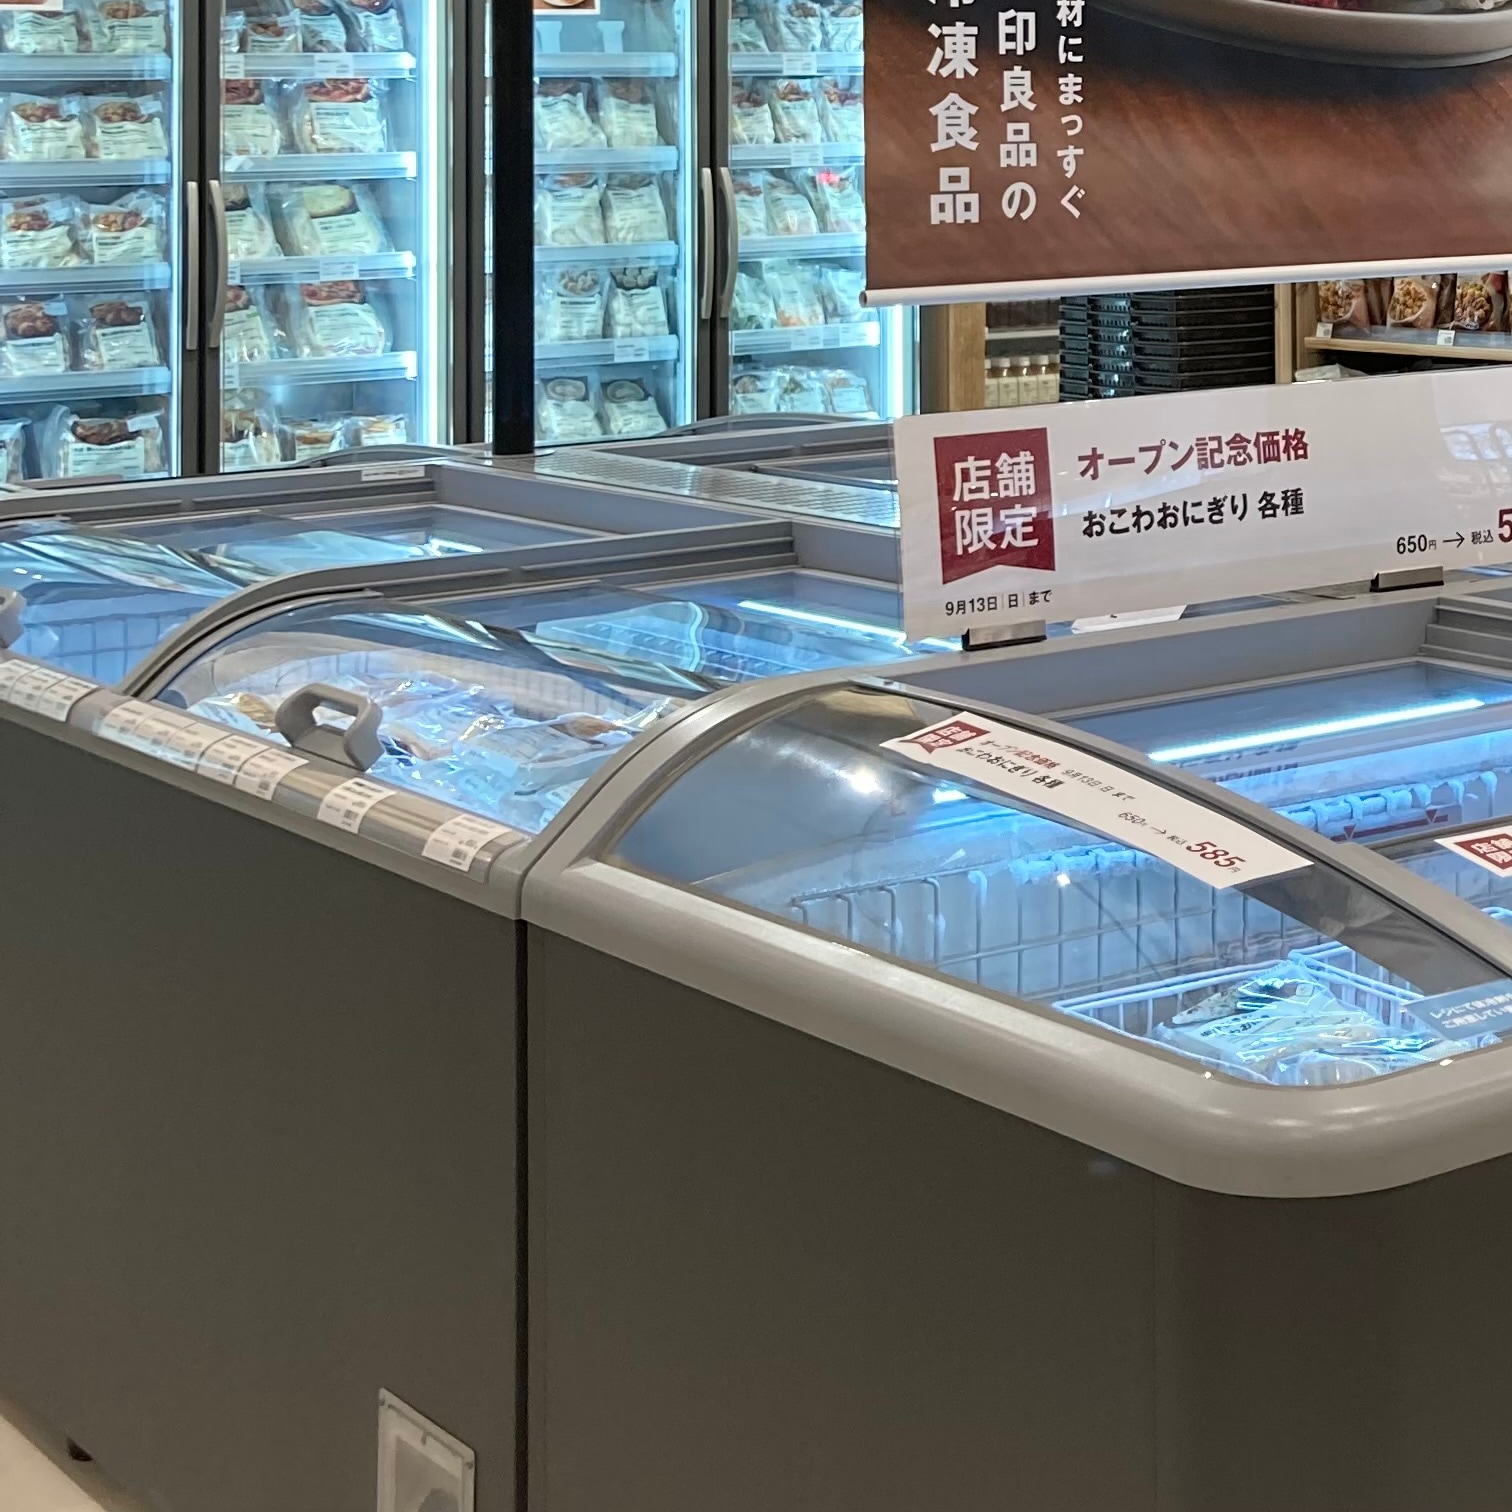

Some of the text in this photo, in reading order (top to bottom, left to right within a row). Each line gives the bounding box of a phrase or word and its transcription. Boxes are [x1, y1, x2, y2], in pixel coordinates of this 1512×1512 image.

[952, 449, 1036, 502] 店舗
[1077, 427, 1310, 481] オープン記念価格
[955, 502, 1040, 556] 限定
[1082, 487, 1306, 539] おこわおにぎり 各種
[1396, 533, 1437, 556] 650円
